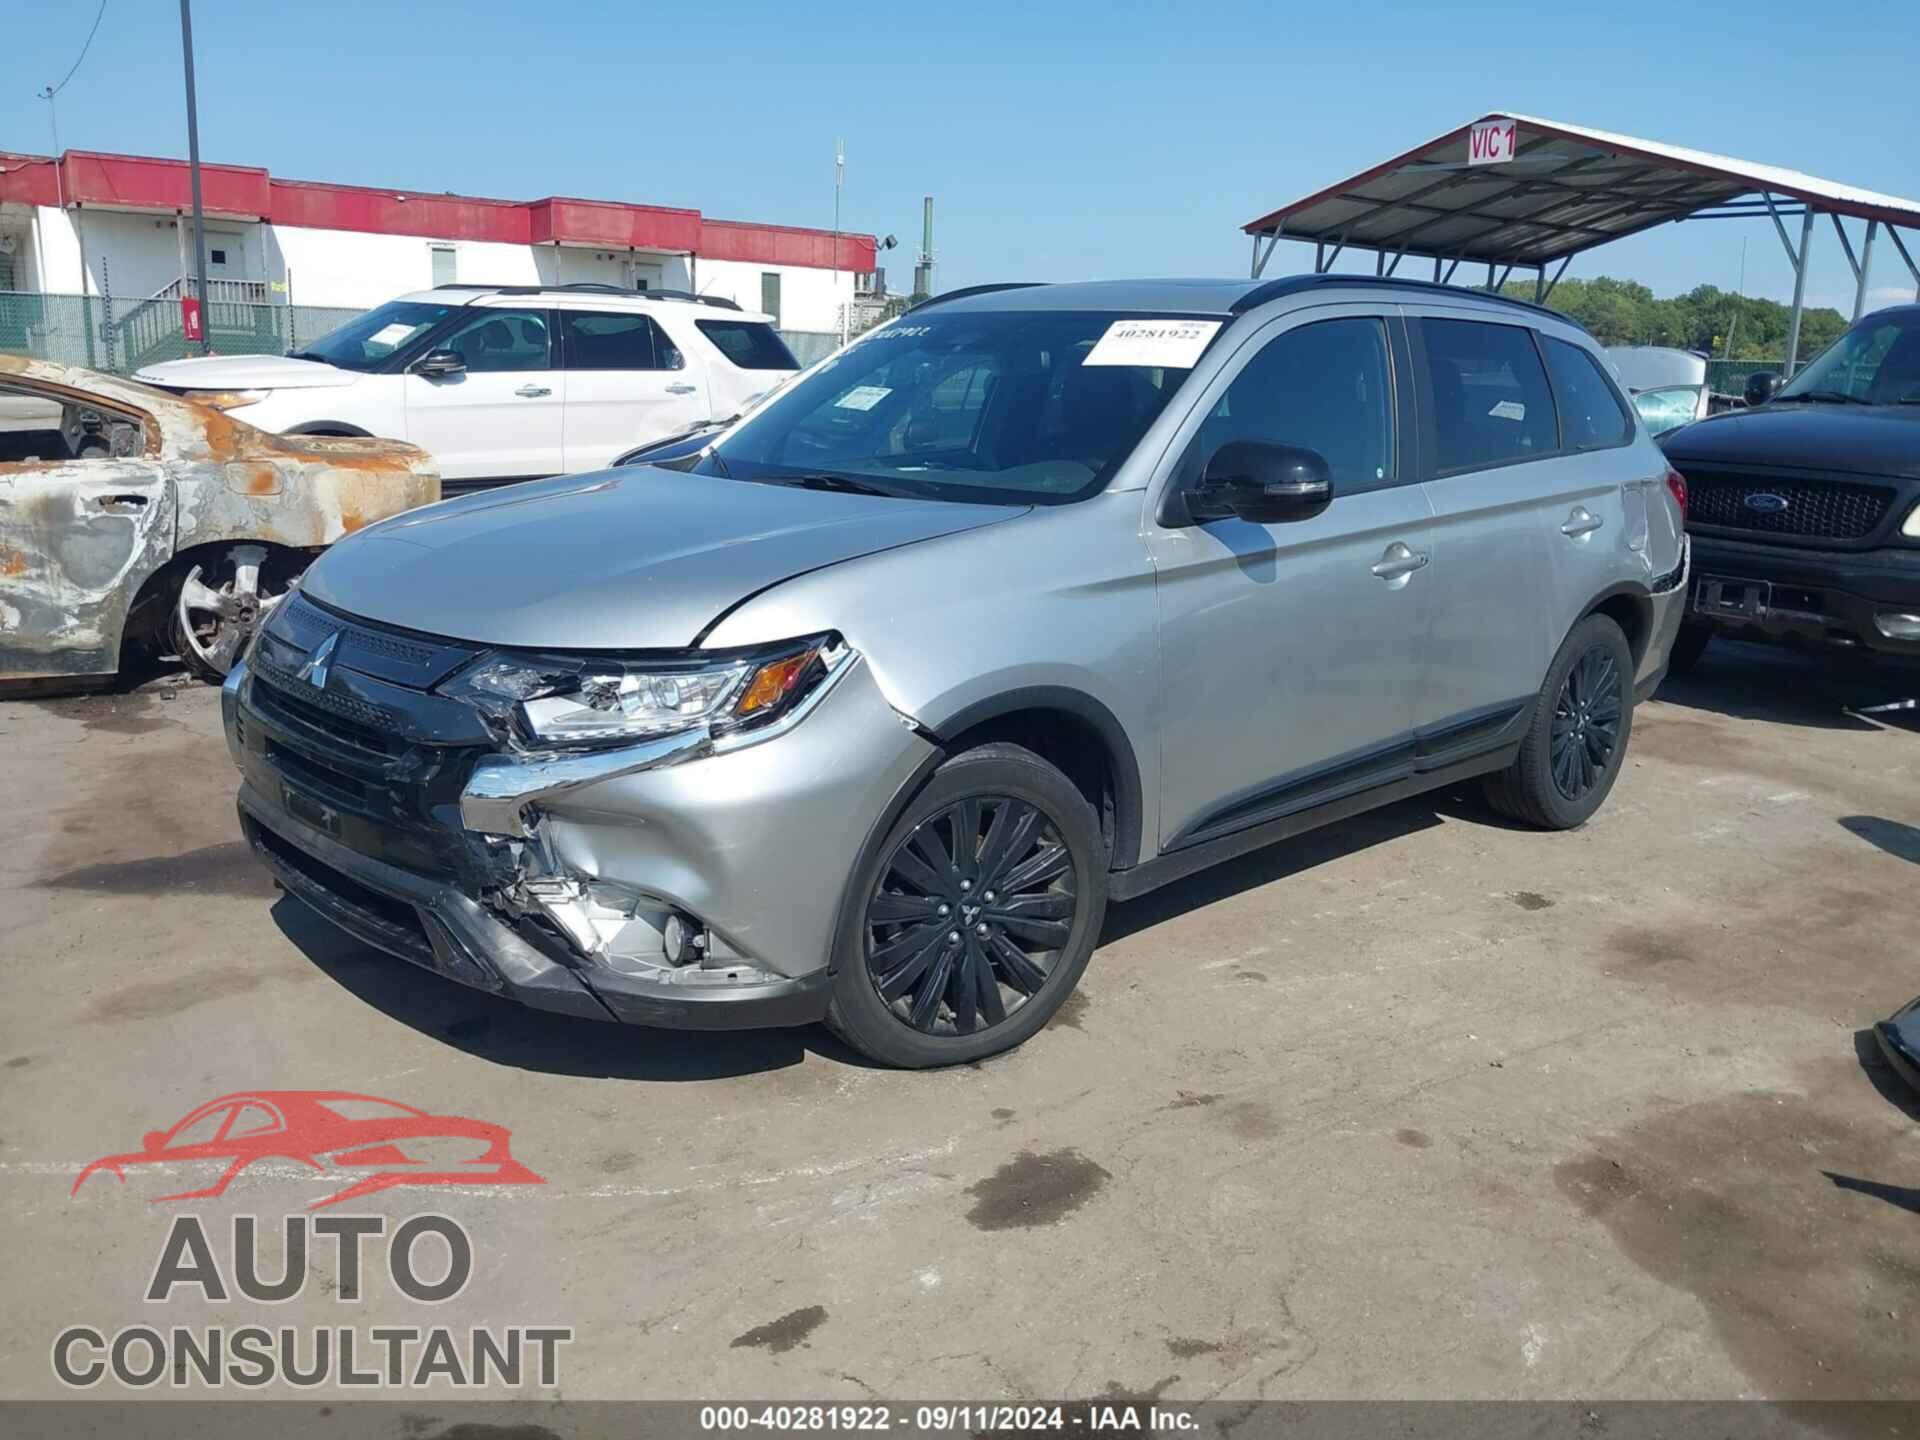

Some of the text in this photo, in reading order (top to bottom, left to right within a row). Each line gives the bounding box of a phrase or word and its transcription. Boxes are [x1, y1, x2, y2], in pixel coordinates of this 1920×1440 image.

[1472, 124, 1514, 158] VIC 1
[1114, 329, 1200, 340] 40281922
